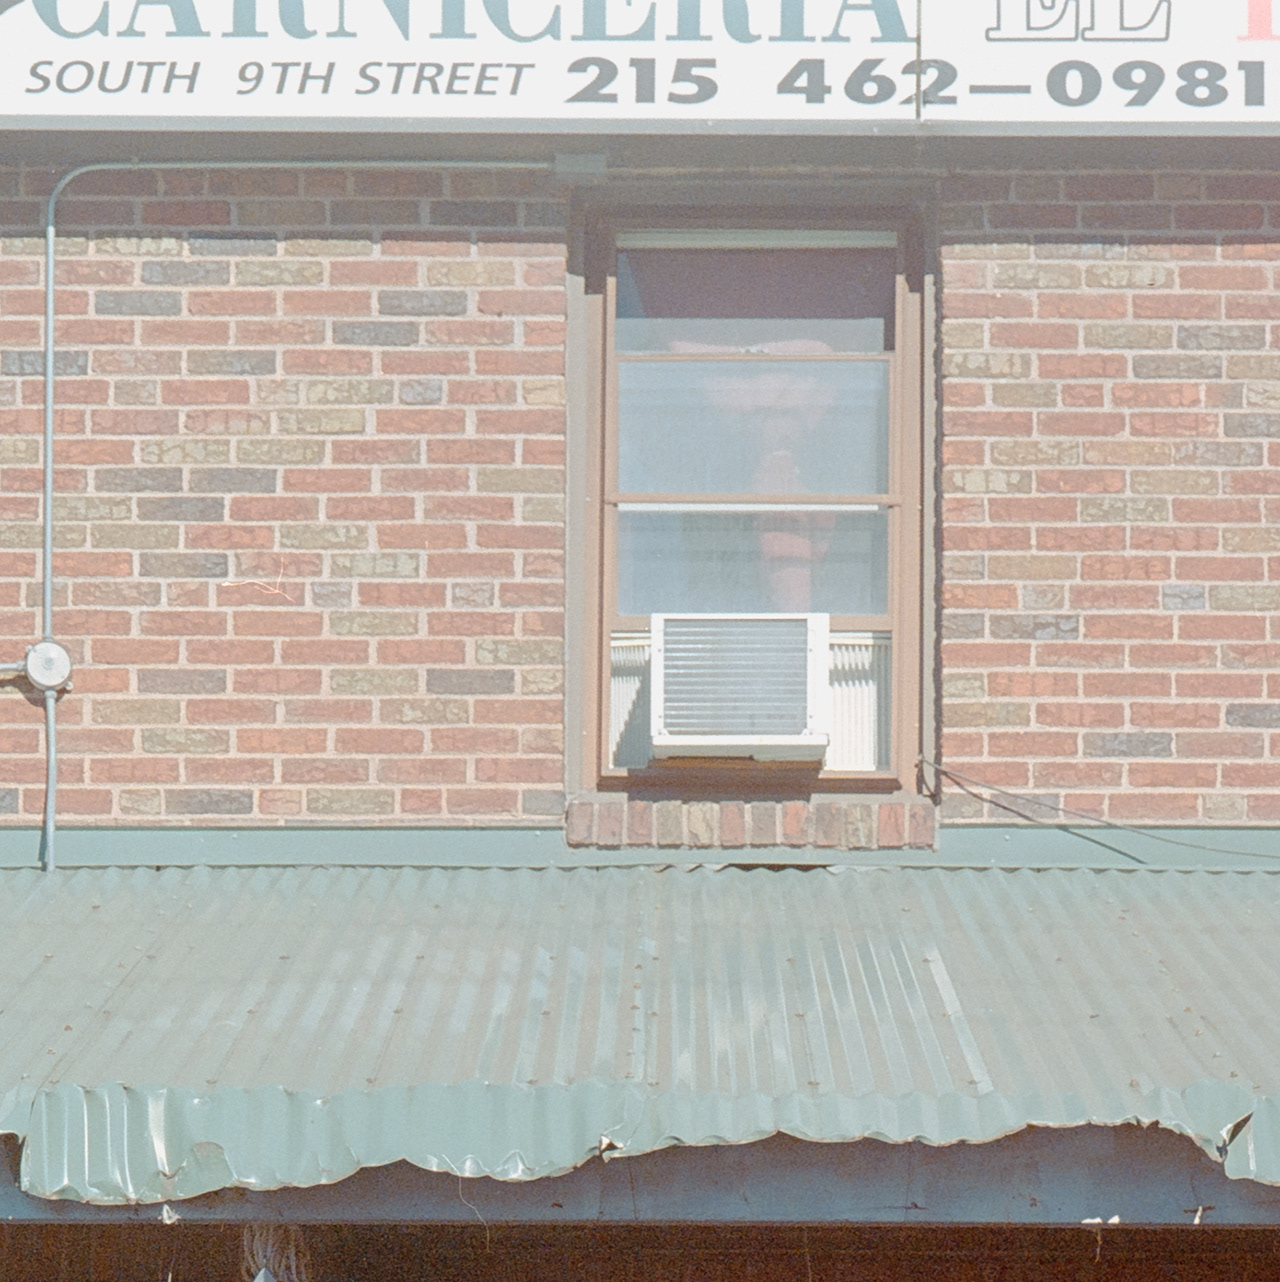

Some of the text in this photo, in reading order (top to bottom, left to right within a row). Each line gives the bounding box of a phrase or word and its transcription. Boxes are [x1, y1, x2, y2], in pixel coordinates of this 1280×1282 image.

[25, 60, 201, 94] SOUTH
[236, 61, 335, 95] 9TH
[355, 62, 535, 96] STREET
[564, 56, 719, 104] 215
[777, 57, 1265, 107] 462-0981
